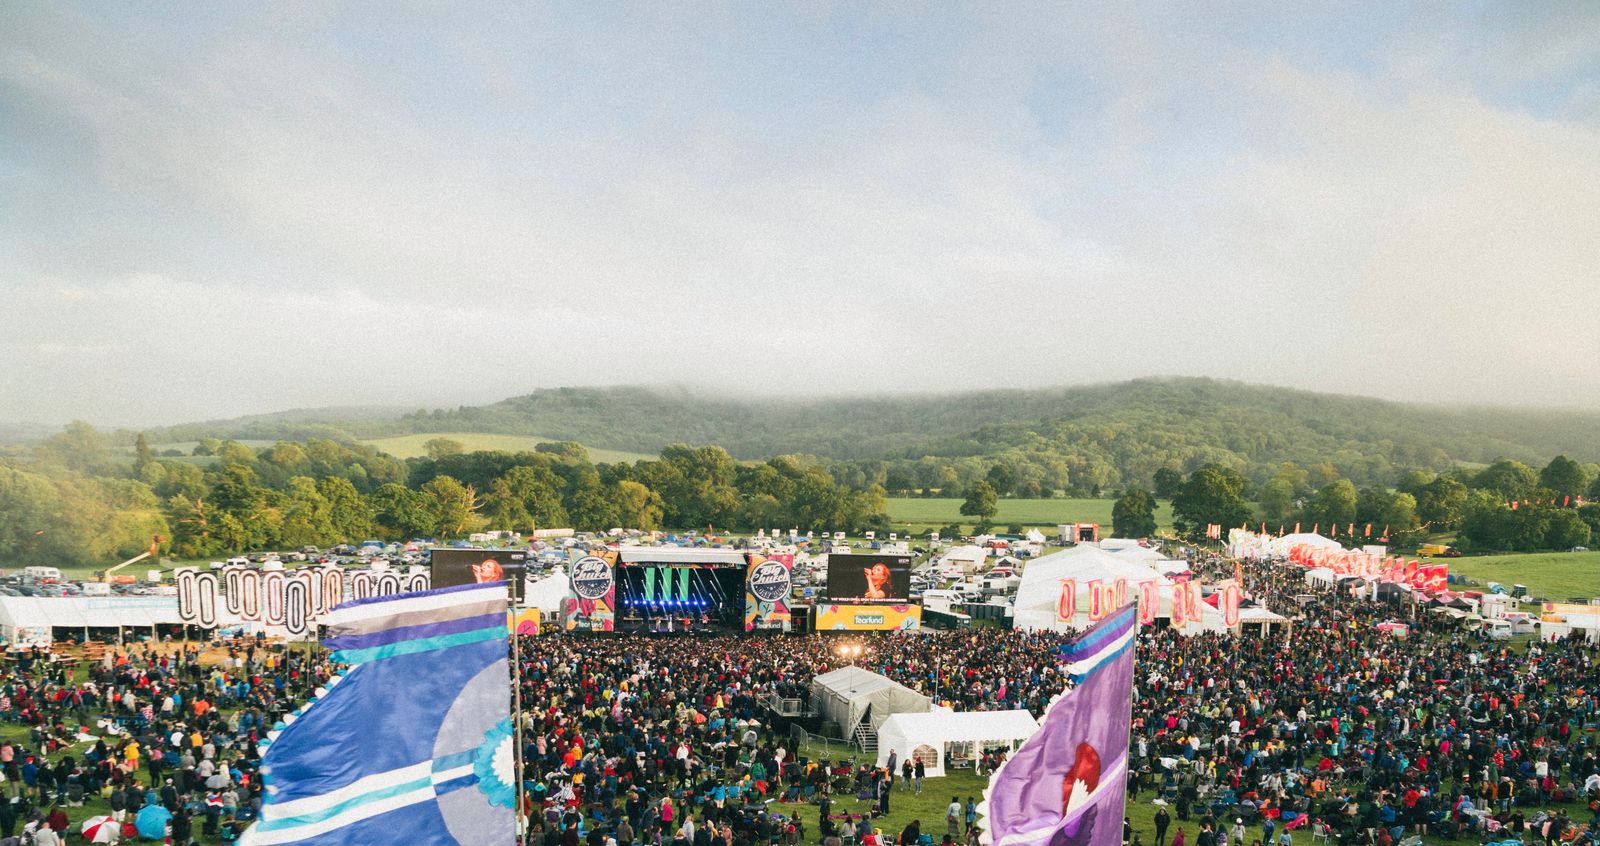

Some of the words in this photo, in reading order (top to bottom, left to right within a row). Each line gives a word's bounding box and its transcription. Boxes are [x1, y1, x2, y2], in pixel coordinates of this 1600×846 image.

[574, 567, 611, 580] Church
[760, 565, 782, 576] Big
[751, 572, 788, 584] Church
